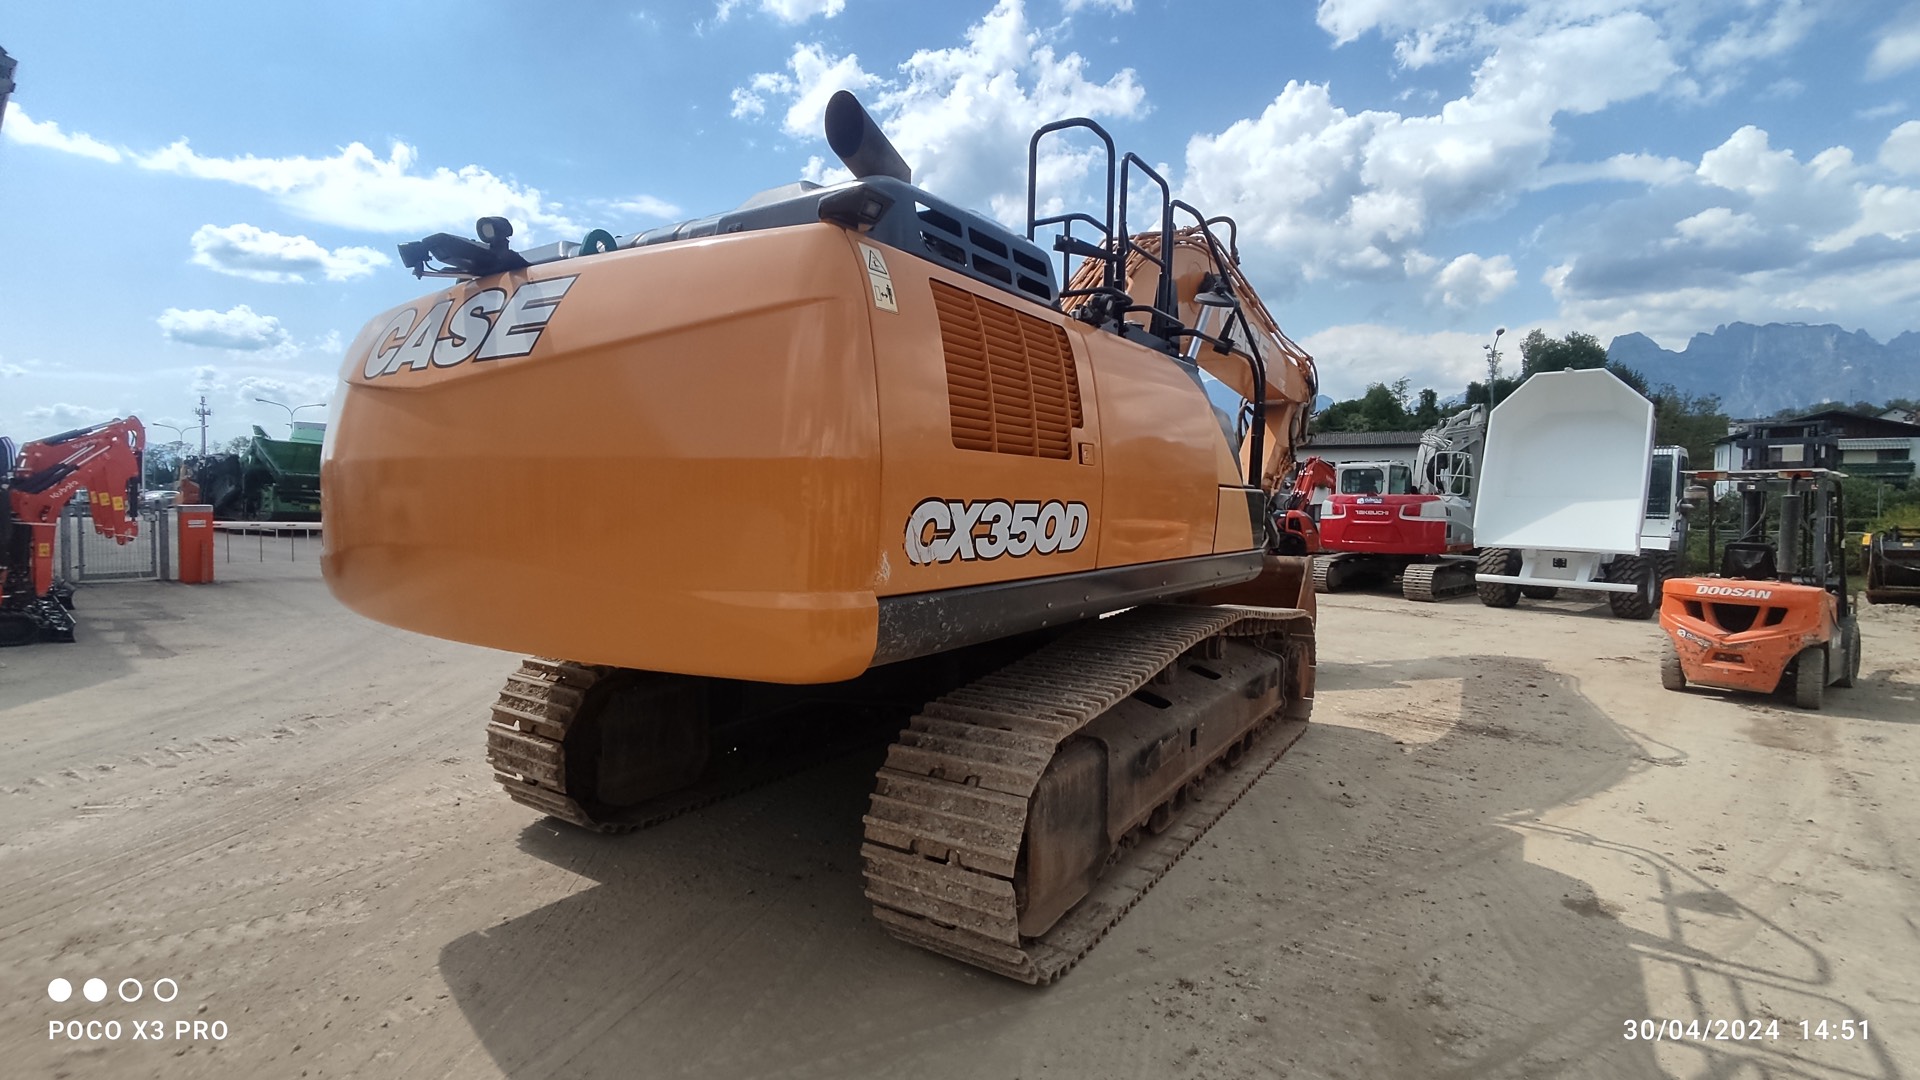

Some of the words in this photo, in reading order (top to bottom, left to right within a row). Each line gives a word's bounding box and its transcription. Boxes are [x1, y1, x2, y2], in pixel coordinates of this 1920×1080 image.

[364, 273, 581, 379] CASE
[49, 480, 79, 499] Kubota
[903, 497, 1090, 566] CX350D
[1696, 585, 1772, 600] DOOSAN
